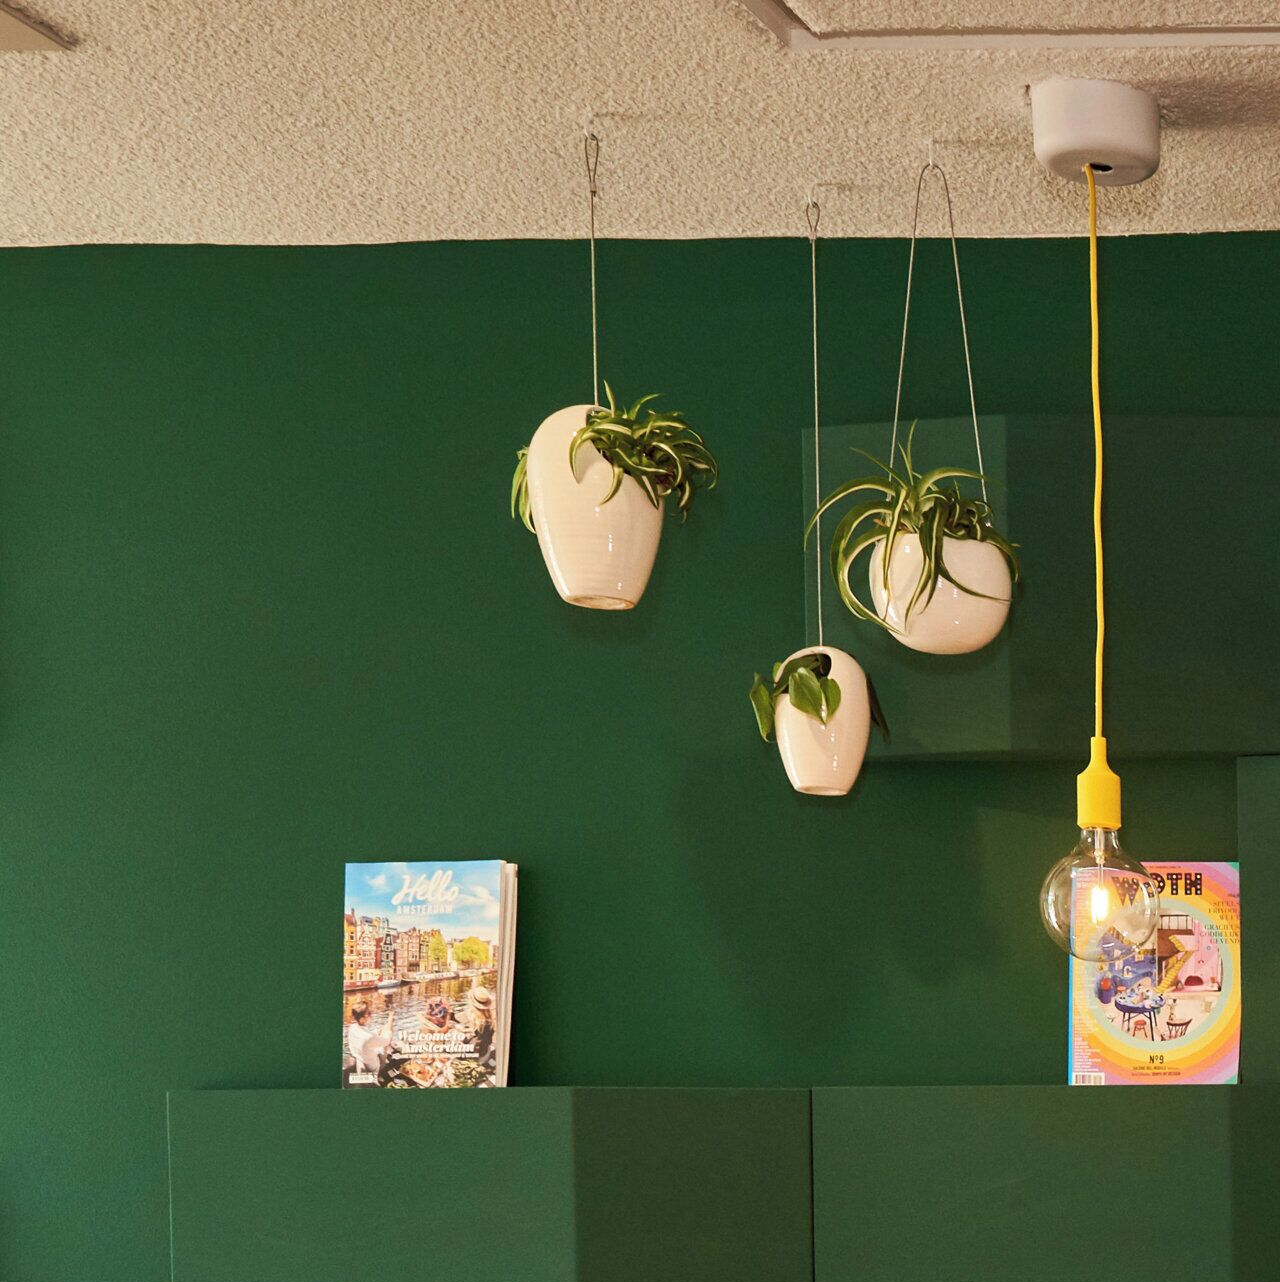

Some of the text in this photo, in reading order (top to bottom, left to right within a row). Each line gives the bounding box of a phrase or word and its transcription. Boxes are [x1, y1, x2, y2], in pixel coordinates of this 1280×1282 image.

[391, 869, 459, 906] Hello
[1112, 872, 1203, 907] WOTH
[397, 904, 453, 914] AMSTERDAM
[397, 1030, 466, 1041] Welcome to
[401, 1041, 475, 1053] Amsterdam
